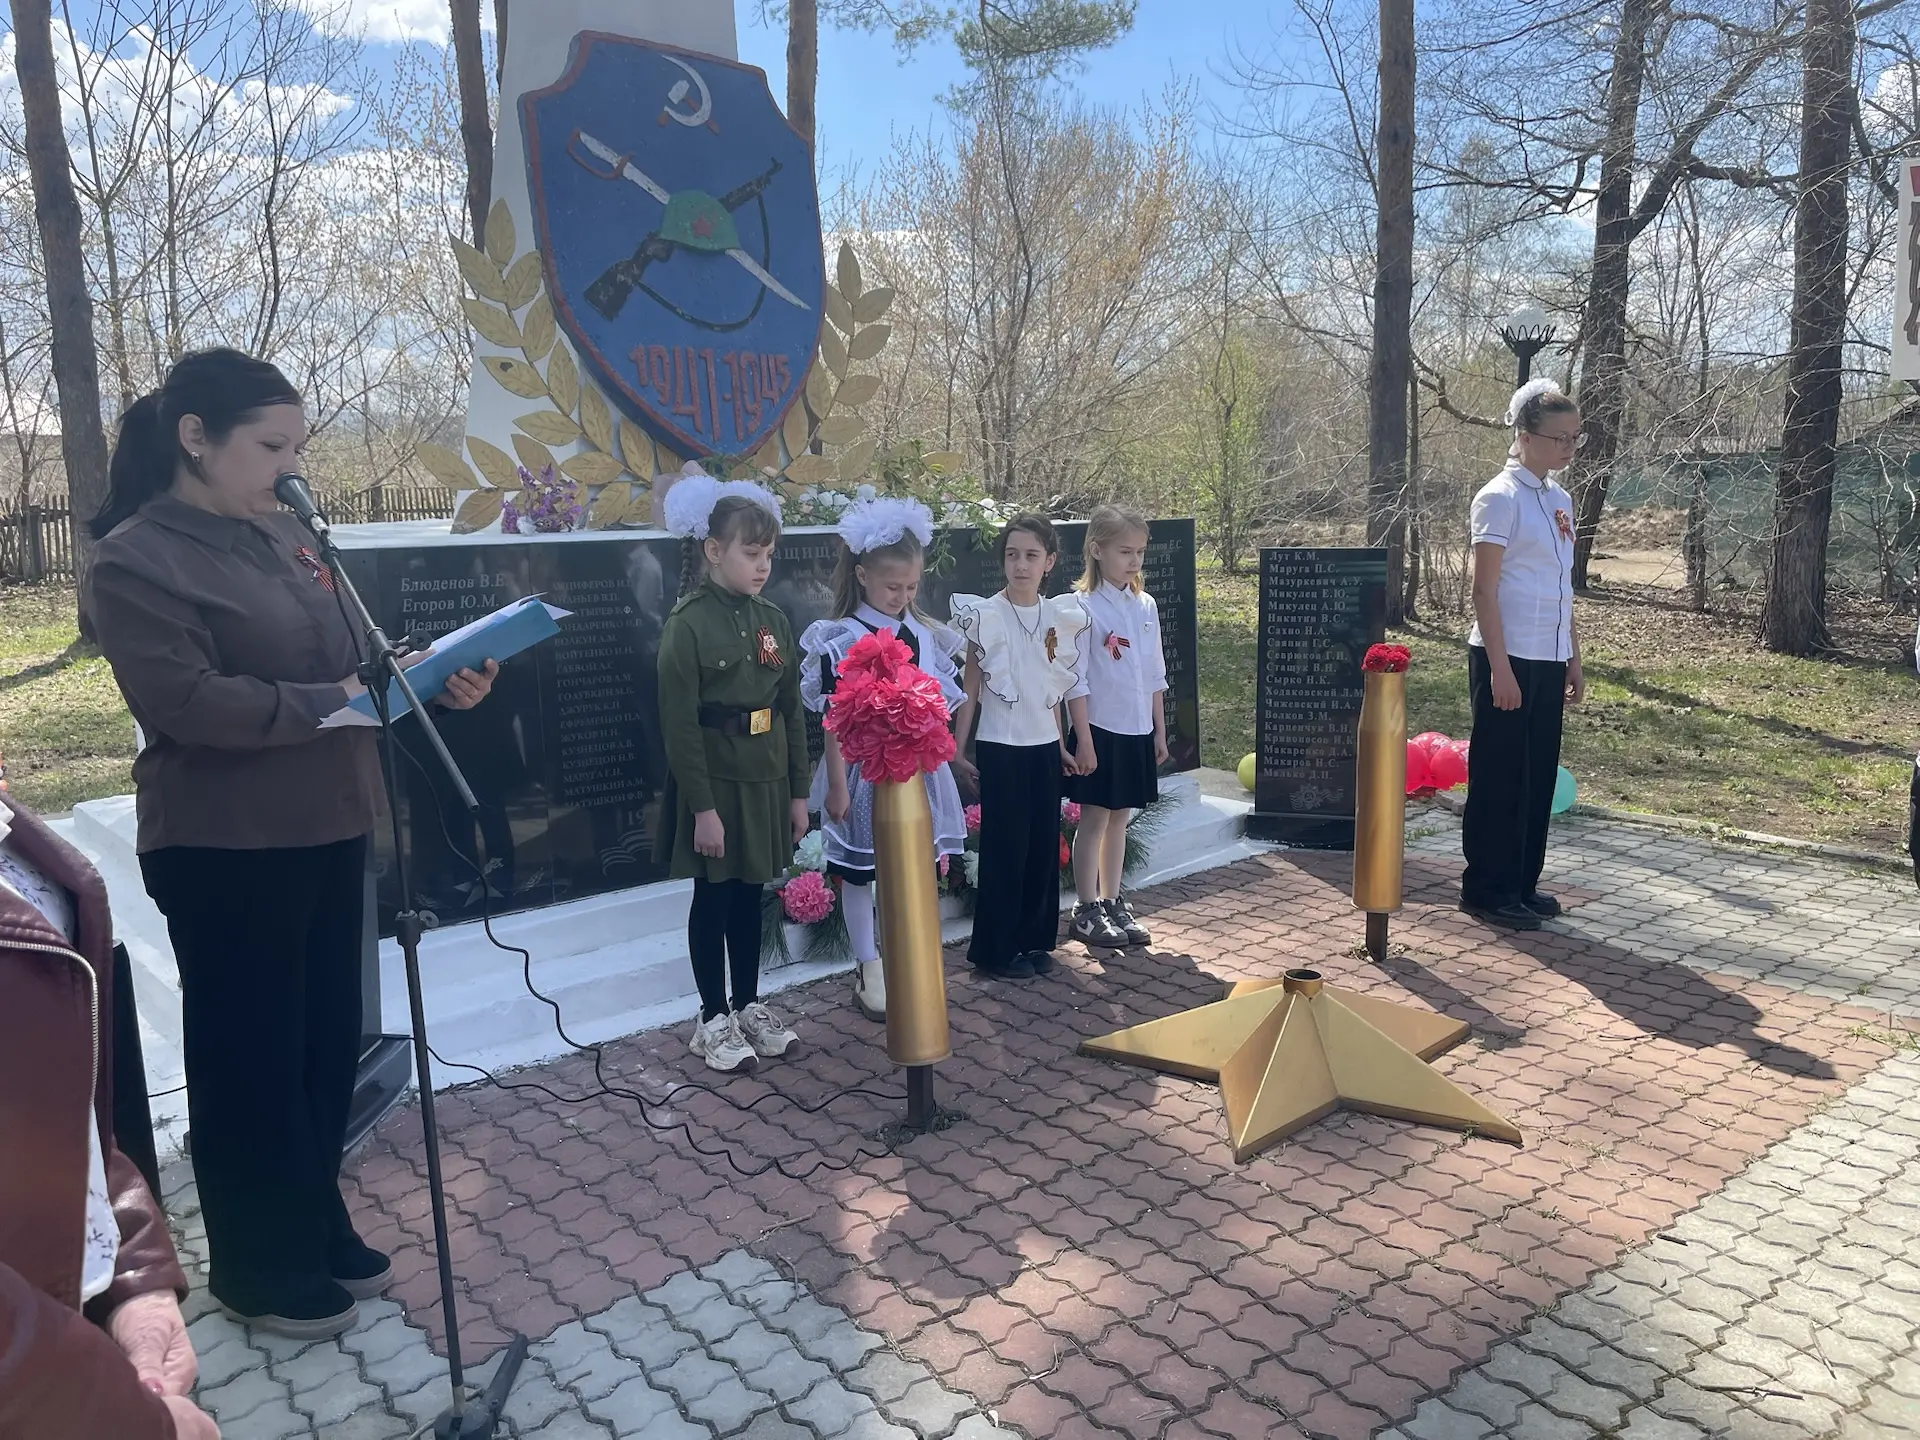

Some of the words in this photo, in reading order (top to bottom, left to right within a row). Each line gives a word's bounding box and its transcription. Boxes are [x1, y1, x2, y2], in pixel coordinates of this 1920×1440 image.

[1269, 551, 1290, 563] Лут
[1294, 551, 1320, 561] К.М.
[1269, 564, 1310, 575] Маруга
[1315, 564, 1339, 573] П.С.
[400, 577, 475, 592] Блюденов
[1268, 576, 1336, 588] Мазуркевич
[1340, 576, 1363, 586] А.У.
[1268, 589, 1318, 600] Микулец
[1322, 589, 1349, 598] Е.Ю.
[402, 598, 455, 615] Егоров
[460, 594, 500, 609] Ю.М.
[1268, 601, 1317, 612] Микулец
[1320, 601, 1349, 611] А.Ю.
[1267, 613, 1317, 623] Никитин
[1321, 613, 1345, 623] В.С.
[404, 618, 457, 633] Исаков
[559, 620, 623, 632] ОНДАРЕНКО
[1267, 625, 1301, 635] Сахно
[1267, 637, 1308, 647] Саяпин
[1312, 638, 1335, 648] Г.С.
[1266, 650, 1321, 661] Севрюков
[1265, 674, 1302, 686] Сырко
[1265, 686, 1337, 697] Ходаковский
[1265, 698, 1327, 709] Чижевский
[1264, 709, 1304, 720] Волков
[1264, 721, 1325, 734] Карпенчук
[1264, 733, 1329, 745] Кривоносов
[1263, 745, 1325, 757] Макаренко
[1328, 746, 1352, 757] Д.А.
[1263, 756, 1311, 768] Макаров
